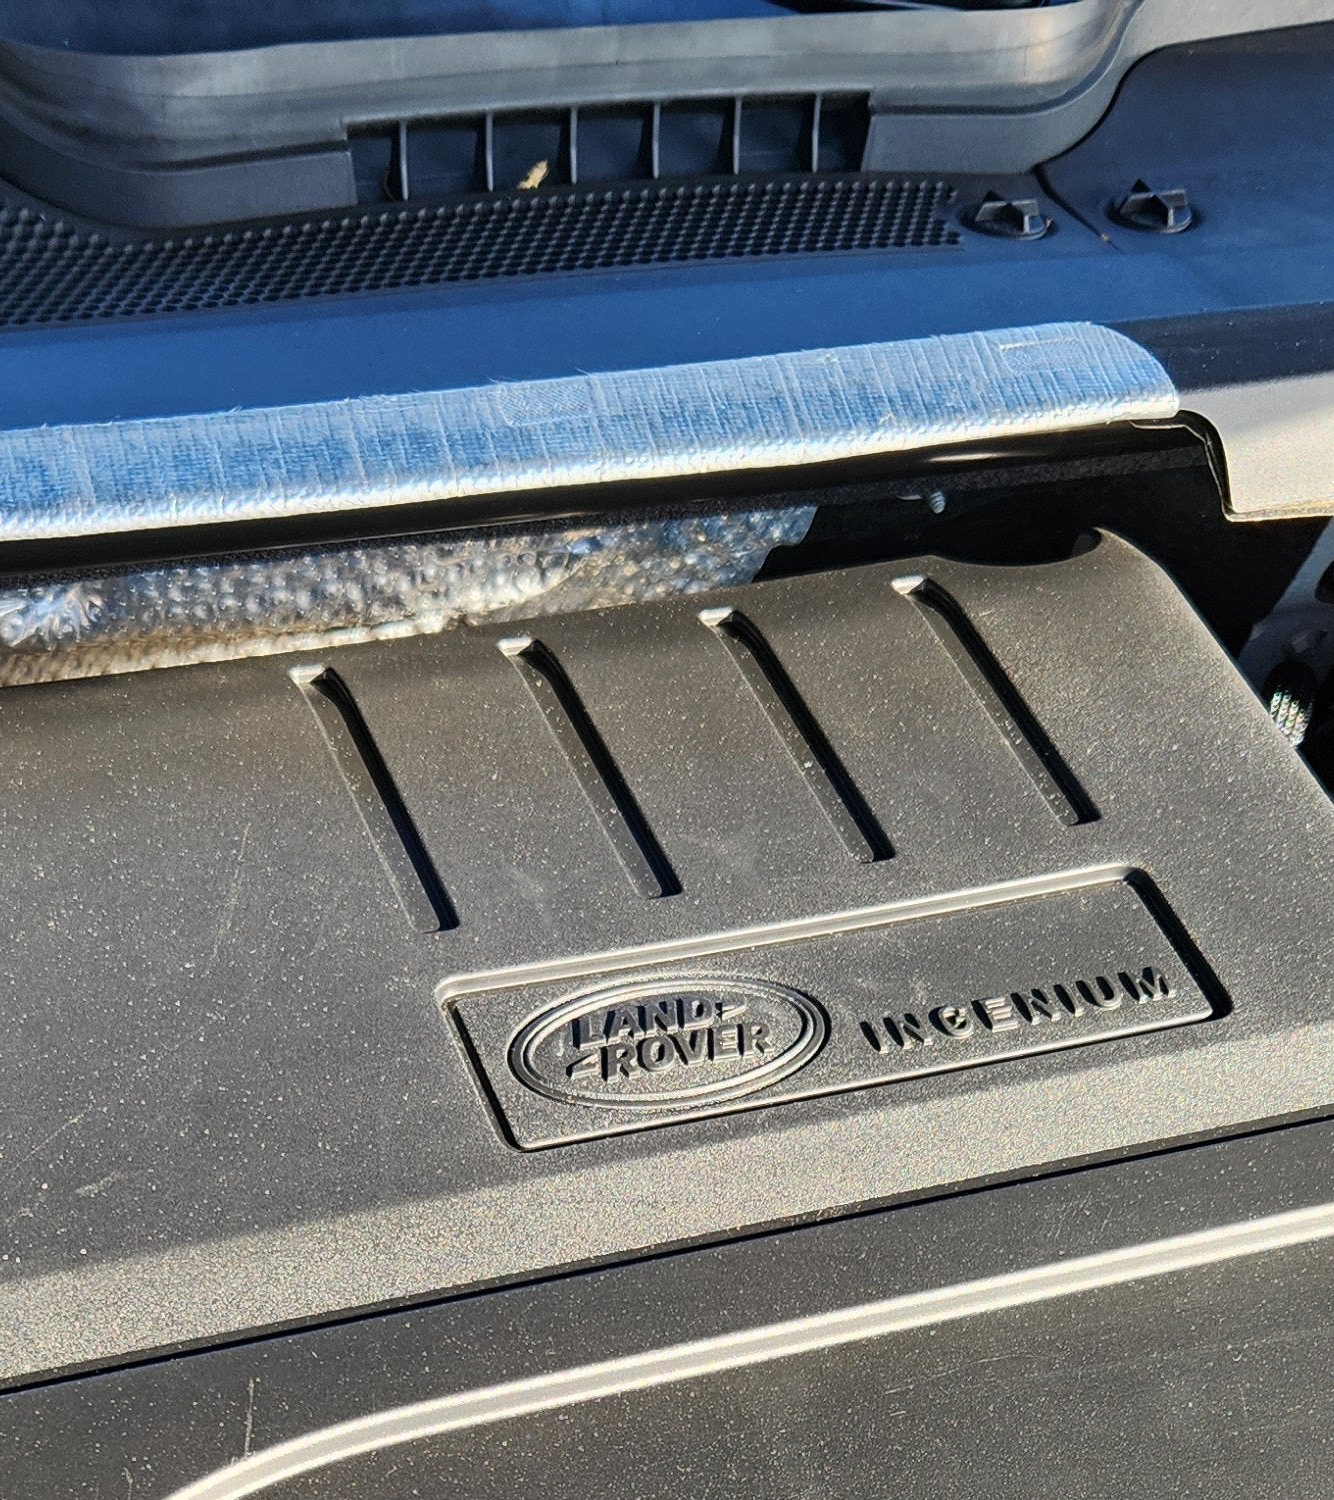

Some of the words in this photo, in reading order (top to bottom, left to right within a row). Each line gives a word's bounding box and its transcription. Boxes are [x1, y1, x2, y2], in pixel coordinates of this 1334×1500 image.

[571, 997, 716, 1050] LAND
[859, 966, 1178, 1055] INGENIUM
[599, 1021, 777, 1083] ROVER
